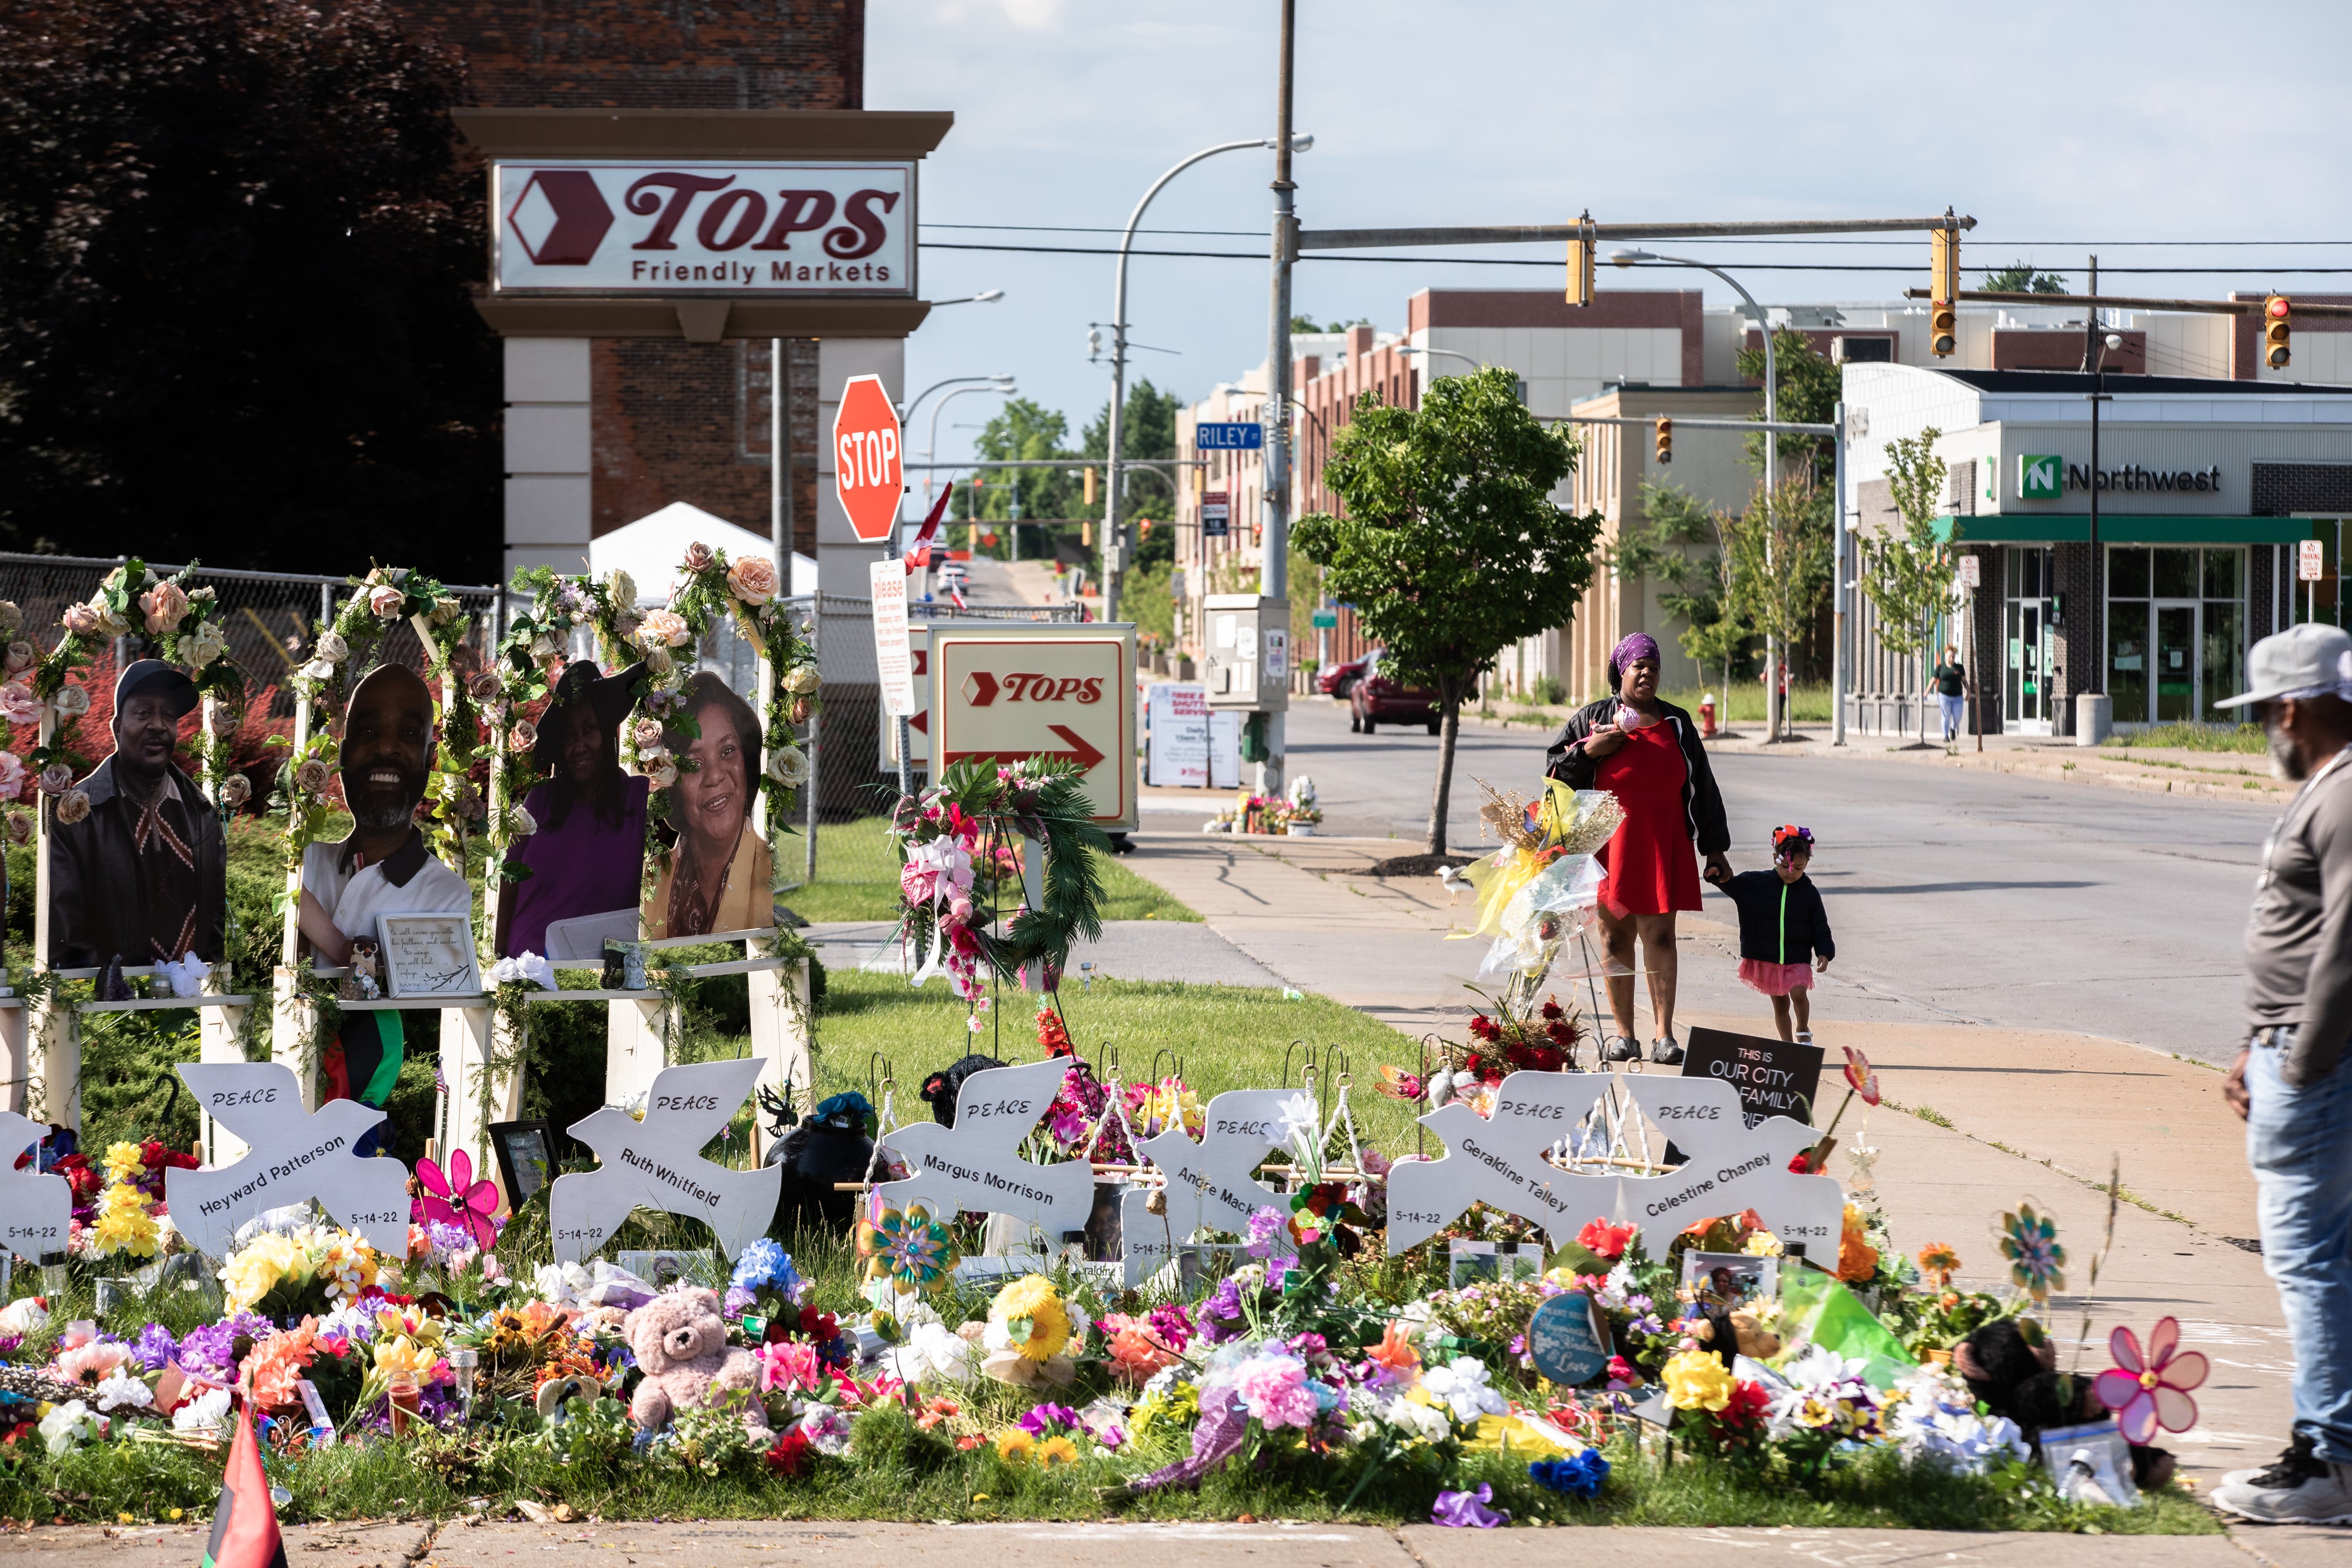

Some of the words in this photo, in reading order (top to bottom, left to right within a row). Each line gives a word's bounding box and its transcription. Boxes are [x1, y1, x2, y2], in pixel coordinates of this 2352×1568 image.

[624, 172, 900, 260] TOPS
[632, 260, 756, 285] Friendly
[771, 260, 890, 282] Markets
[1199, 427, 1248, 446] RILEY
[840, 428, 897, 490] STOP
[2030, 463, 2053, 490] N
[2069, 464, 2220, 492] Northwest
[874, 576, 903, 605] please
[1003, 673, 1104, 704] TOPS
[390, 927, 397, 935] He
[395, 961, 406, 969] you
[420, 957, 433, 969] find
[1737, 1048, 1760, 1061] THIS
[1762, 1052, 1773, 1062] IS
[1710, 1060, 1749, 1081] OUR
[1752, 1067, 1794, 1087] CITY
[212, 1088, 277, 1106] PEACE
[657, 1095, 719, 1110] PEACE
[1740, 1086, 1798, 1109] FAMILY
[967, 1100, 1031, 1118] PEACE
[1501, 1101, 1565, 1119] PEACE
[1659, 1105, 1721, 1119] PEACE
[199, 1172, 268, 1216] Heyward
[270, 1136, 345, 1180] Patterson
[620, 1148, 654, 1174] Ruth
[656, 1165, 721, 1207] Whitfield
[924, 1154, 979, 1182] Margus
[984, 1172, 1053, 1205] Morrison
[1462, 1138, 1524, 1185] Geraldine
[1527, 1180, 1568, 1213] Talley
[1646, 1179, 1715, 1216] Celestine
[1717, 1153, 1771, 1183] Chaney
[352, 1211, 397, 1223] 5-14-22
[1395, 1211, 1441, 1223] 5-14-22
[9, 1226, 56, 1238] 5-14-22
[558, 1227, 602, 1240] 5-14-22
[1783, 1225, 1828, 1237] 5-14-22
[1554, 1351, 1591, 1375] Love
